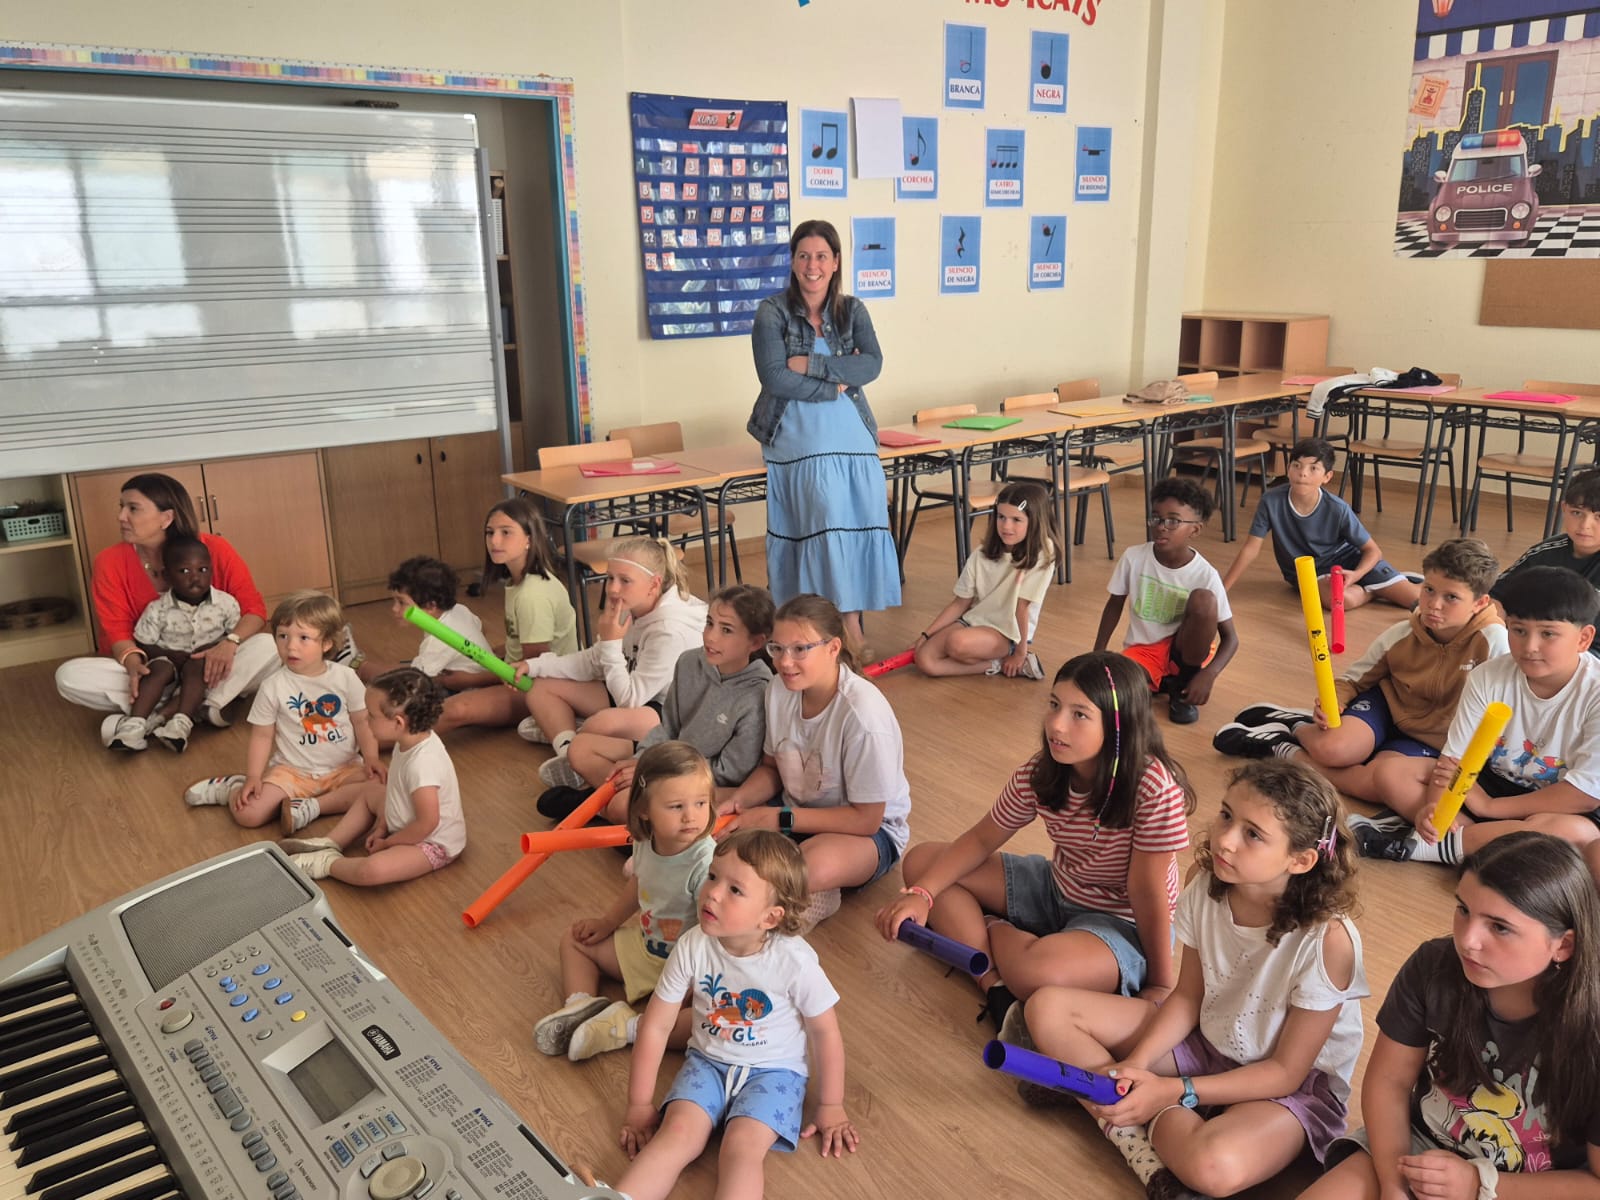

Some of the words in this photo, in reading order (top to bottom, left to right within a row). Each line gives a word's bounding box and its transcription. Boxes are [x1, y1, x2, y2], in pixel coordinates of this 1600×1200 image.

[950, 83, 980, 95] BRANCA
[1036, 88, 1061, 100] NEGRA
[810, 178, 840, 187] CORCHEA
[902, 175, 933, 185] CORCHEA
[685, 185, 696, 197] 10
[711, 185, 720, 197] 11
[732, 185, 742, 197] 12
[1456, 183, 1513, 196] POLICE
[643, 208, 652, 220] 15
[687, 209, 697, 220] 17
[713, 209, 722, 219] 18
[734, 209, 743, 219] 19
[751, 208, 763, 219] 20
[776, 207, 786, 218] 21
[643, 232, 654, 244] 22
[861, 270, 888, 279] SILENCIO
[948, 266, 974, 275] SILENCIO
[859, 280, 866, 288] DE
[867, 279, 891, 288] BRANCA
[947, 275, 955, 284] DE
[956, 275, 975, 283] NEGRA
[298, 727, 346, 746] JUNGL
[373, 1033, 395, 1056] YAMAHA
[385, 1113, 399, 1128] SONG
[478, 1113, 493, 1128] VOICE
[366, 1121, 381, 1137] STYLE
[350, 1131, 365, 1147] VOICE
